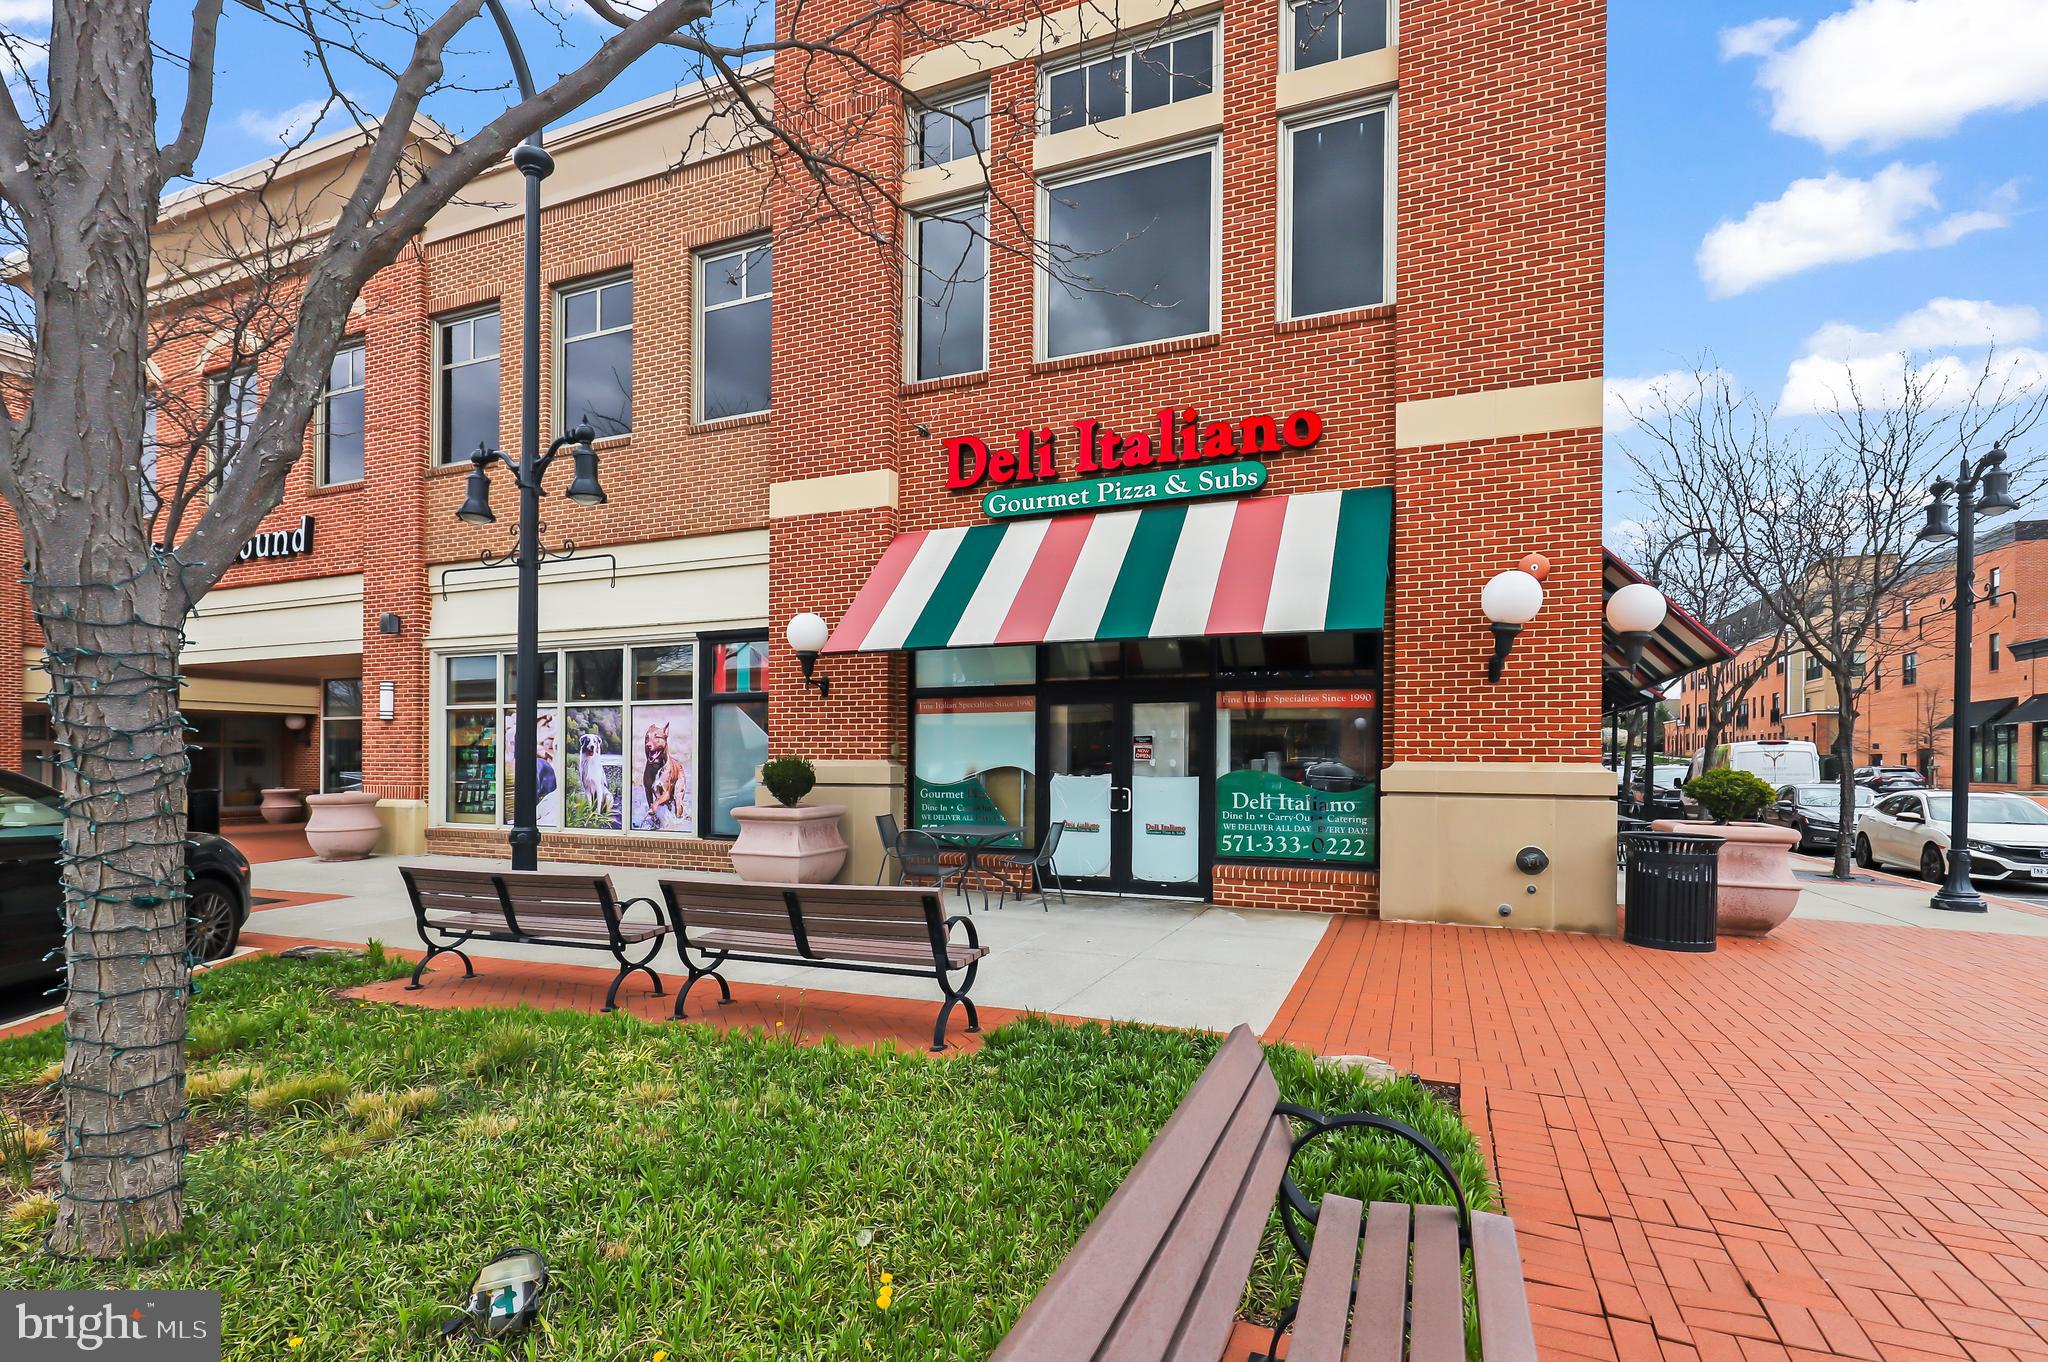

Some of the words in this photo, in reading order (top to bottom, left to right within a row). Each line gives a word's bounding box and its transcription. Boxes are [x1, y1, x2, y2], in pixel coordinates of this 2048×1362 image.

[943, 427, 1057, 489] Deli
[1073, 406, 1323, 473] Italiano
[988, 489, 1090, 515] Gourmet
[1096, 480, 1156, 504] Pizza
[1164, 474, 1191, 495] &
[1199, 468, 1258, 491] Subs
[920, 701, 933, 710] Fine
[935, 701, 957, 709] Italian
[1222, 695, 1241, 704] Fine
[1243, 694, 1272, 703] Italian
[1274, 693, 1320, 704] Specialties
[1321, 693, 1347, 702] Since
[1350, 693, 1372, 702] 1990
[920, 788, 964, 799] Gourmet
[1231, 792, 1272, 810] Deli
[1278, 793, 1356, 812] Italiano
[1222, 811, 1243, 820] Dine
[1245, 812, 1256, 820] In
[1327, 815, 1368, 825] Catering
[1222, 823, 1237, 831] WE
[1238, 823, 1274, 831] DELIVER
[1276, 824, 1292, 832] ALL
[1294, 825, 1312, 833] DAY
[1348, 827, 1368, 835] DAY!
[1221, 834, 1366, 857] 571-333-0222
